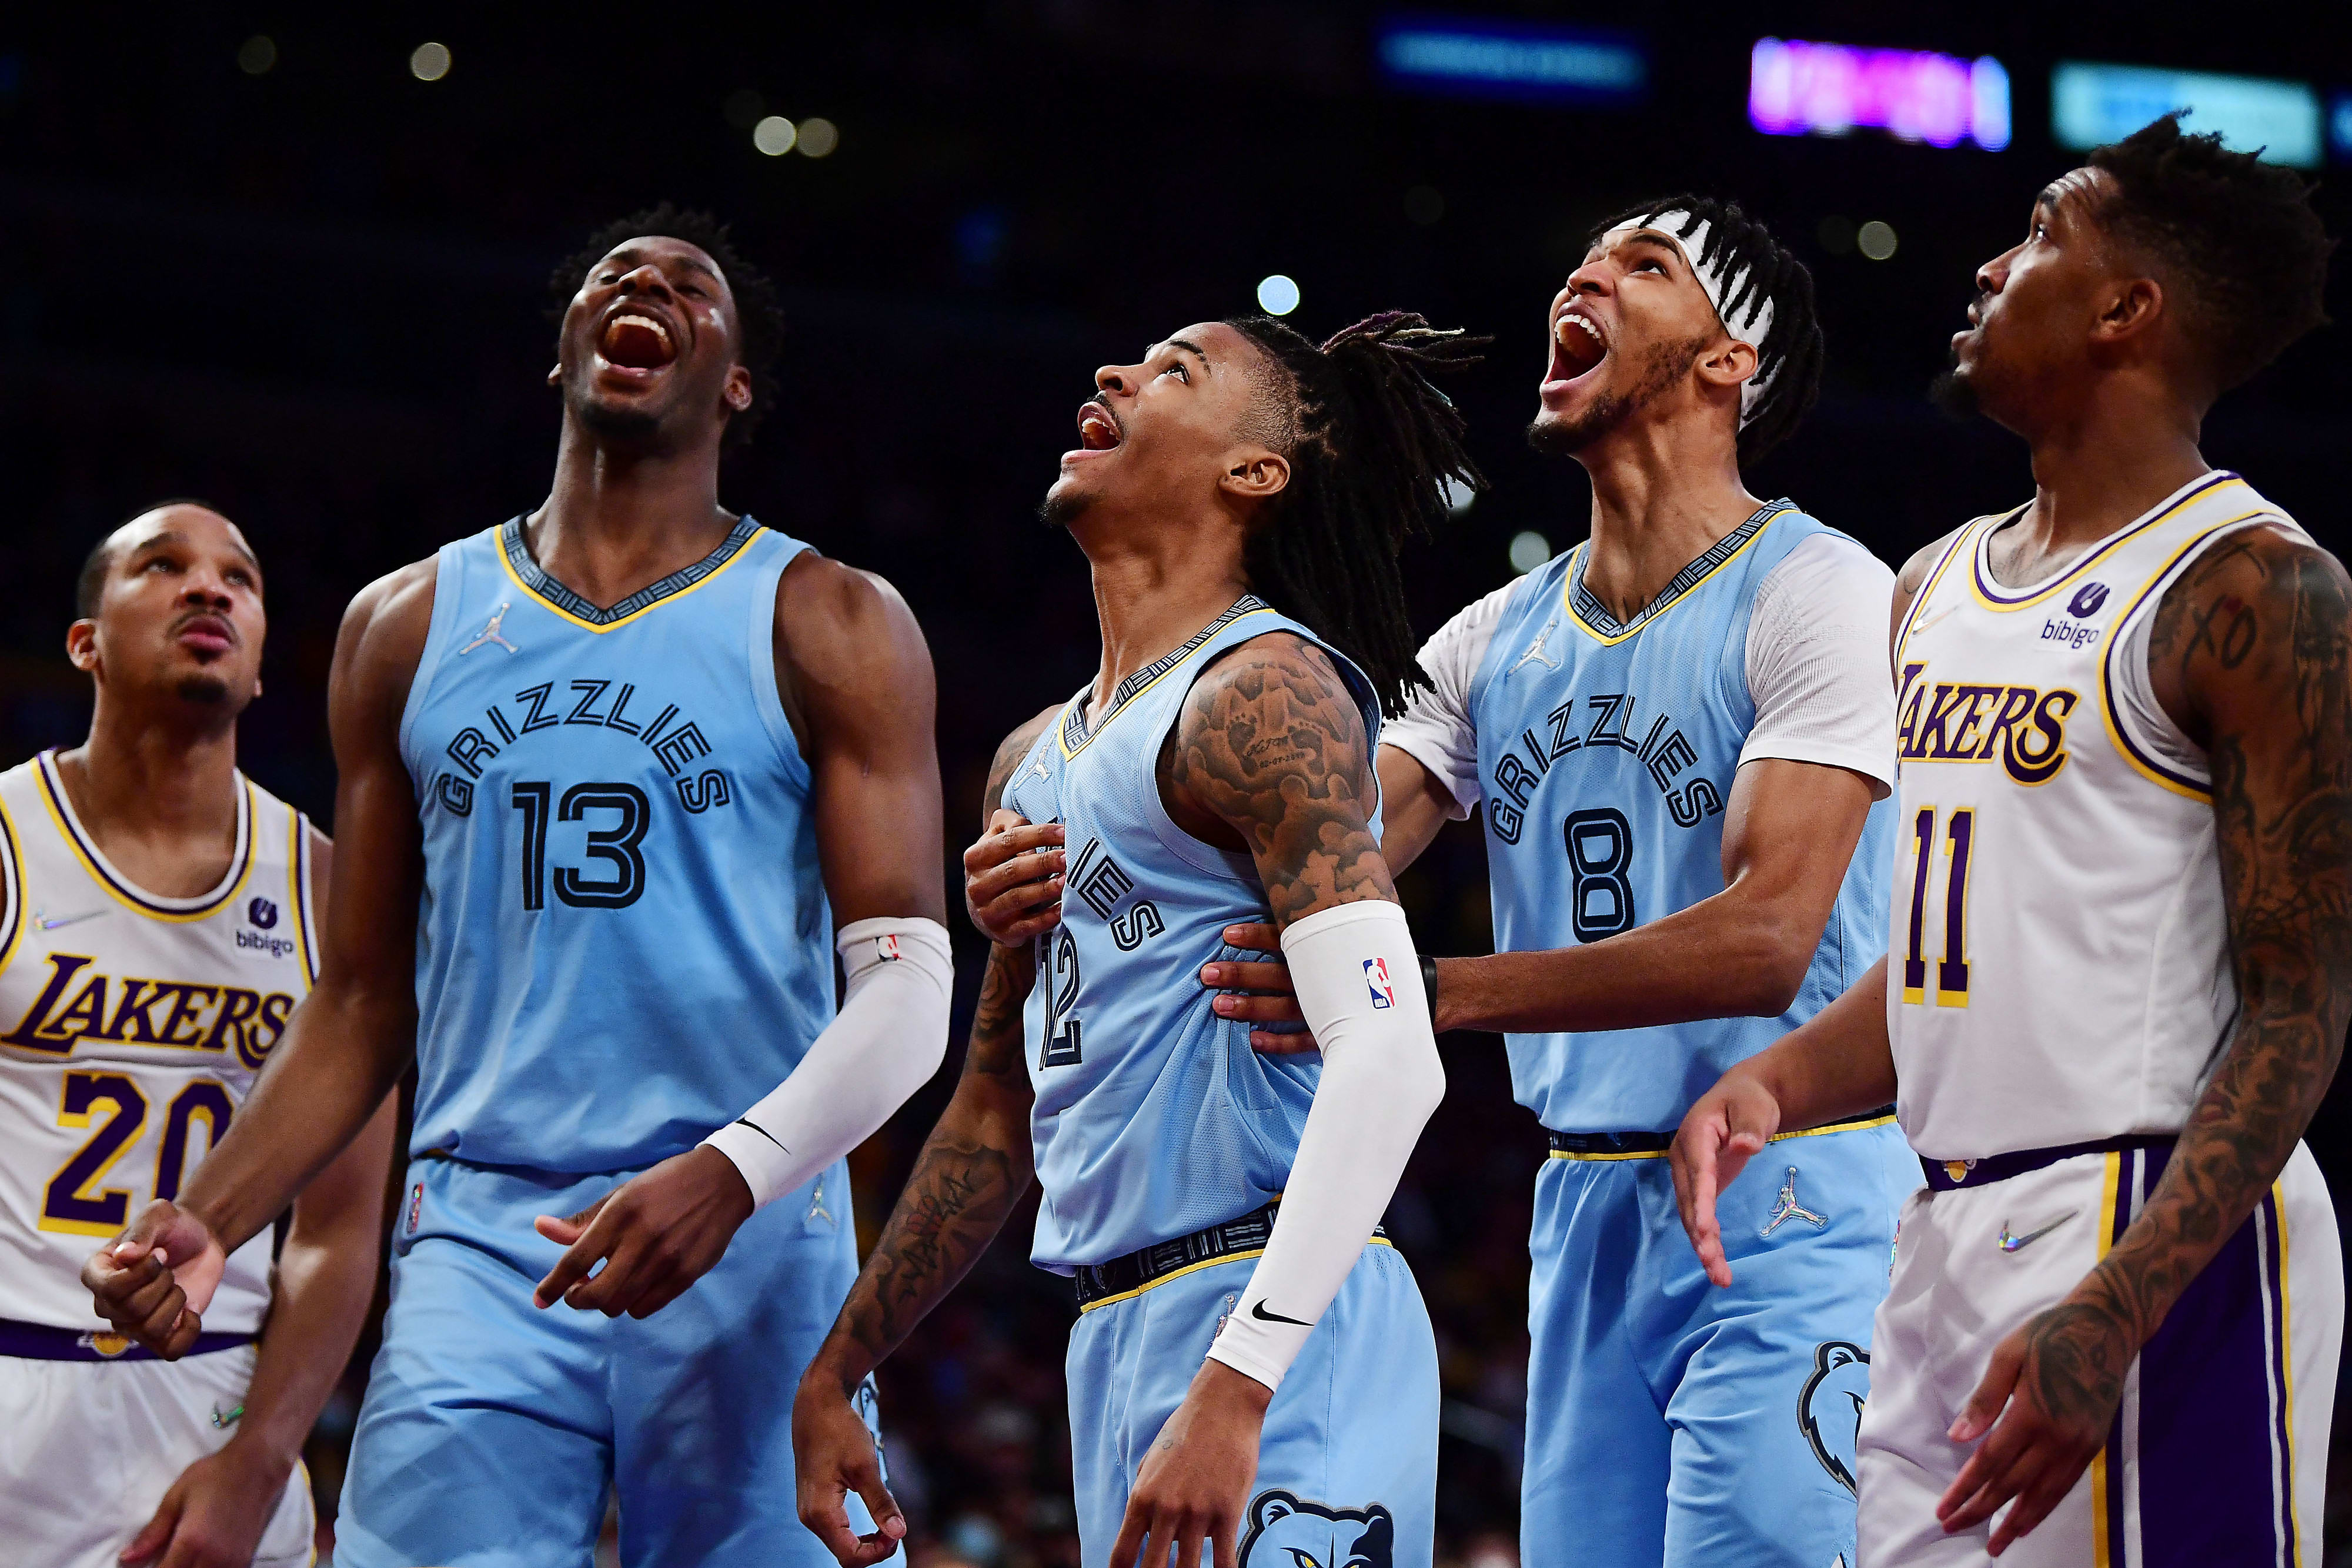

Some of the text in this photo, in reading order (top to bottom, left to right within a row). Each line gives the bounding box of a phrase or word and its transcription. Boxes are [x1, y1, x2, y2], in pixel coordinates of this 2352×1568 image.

[2041, 619, 2099, 649] bibigo
[435, 679, 730, 818] GRIZZLIES
[1491, 693, 1724, 846] GRIZZLIES
[512, 781, 650, 911] 13
[1563, 807, 1635, 943] 8
[1902, 805, 1976, 1009] 11
[1, 951, 294, 1071] LAKERS
[236, 931, 293, 958] bibigo
[38, 1069, 234, 1238] 20
